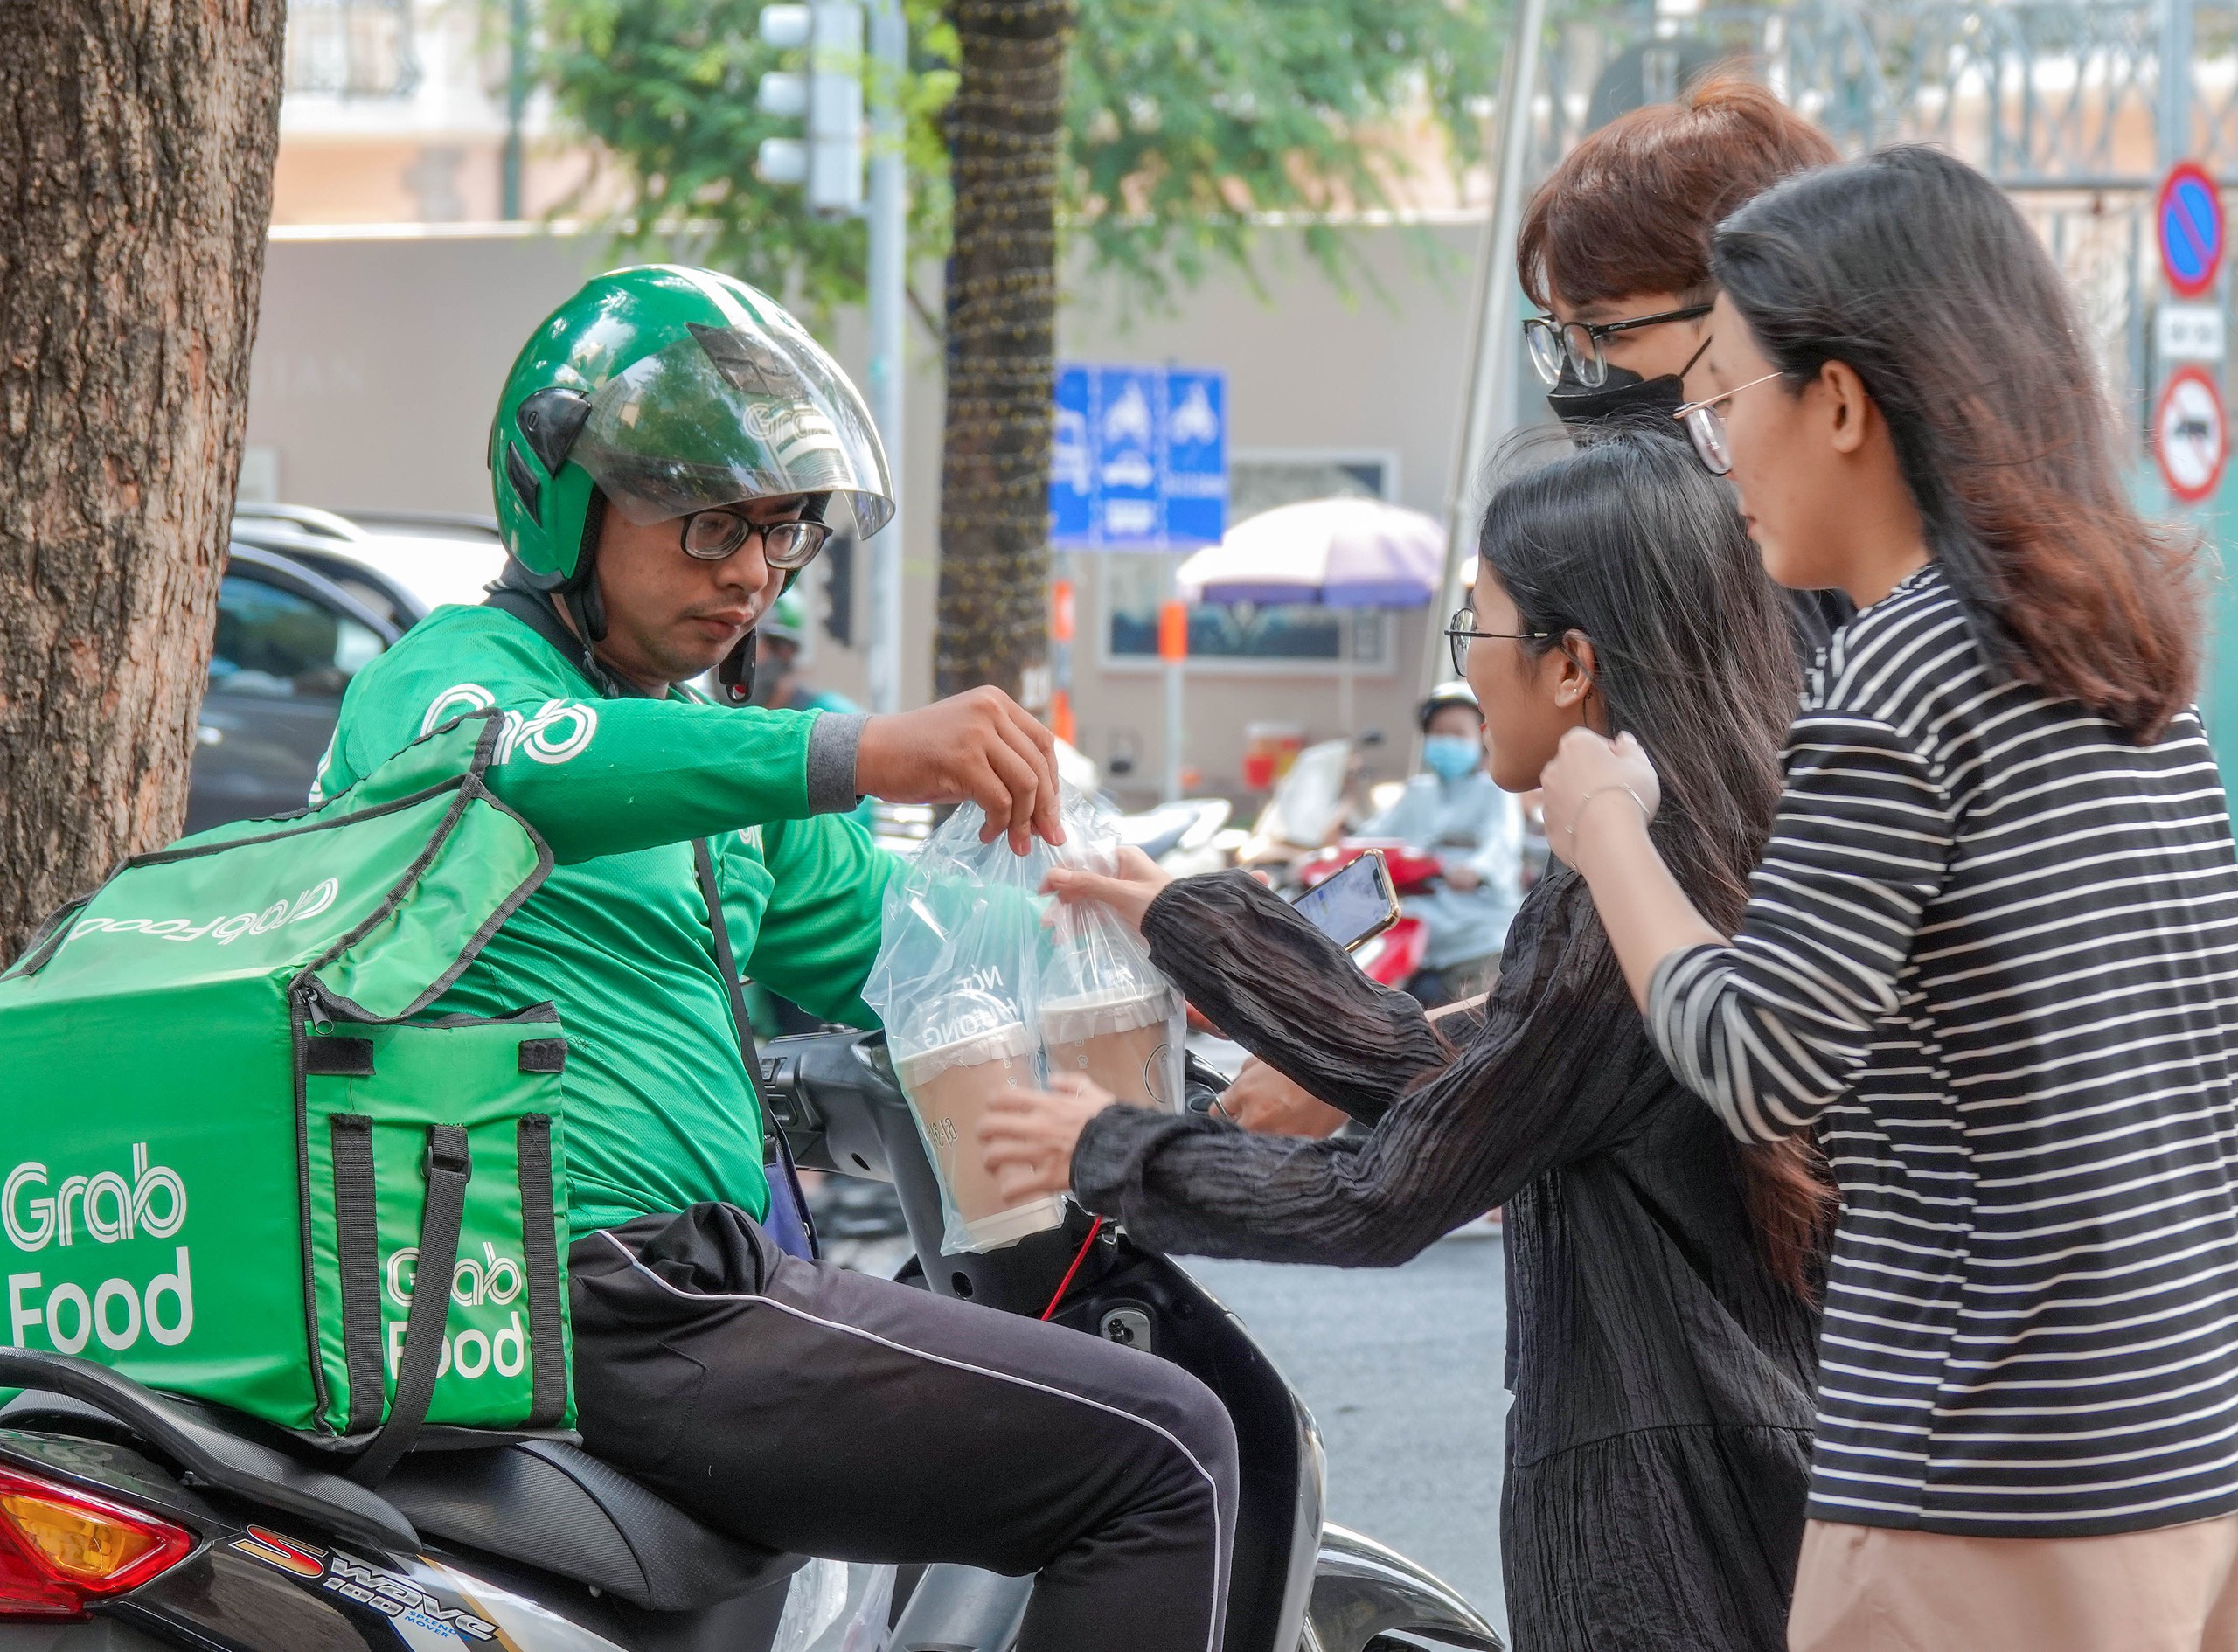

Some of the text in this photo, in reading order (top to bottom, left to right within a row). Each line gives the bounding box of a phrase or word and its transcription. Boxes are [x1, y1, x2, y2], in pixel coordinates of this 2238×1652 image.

[1, 1142, 187, 1252] Grab
[8, 1246, 194, 1355] Food
[386, 1241, 523, 1308] Gab
[323, 1577, 405, 1617] 100
[404, 1615, 449, 1638] MOVER
